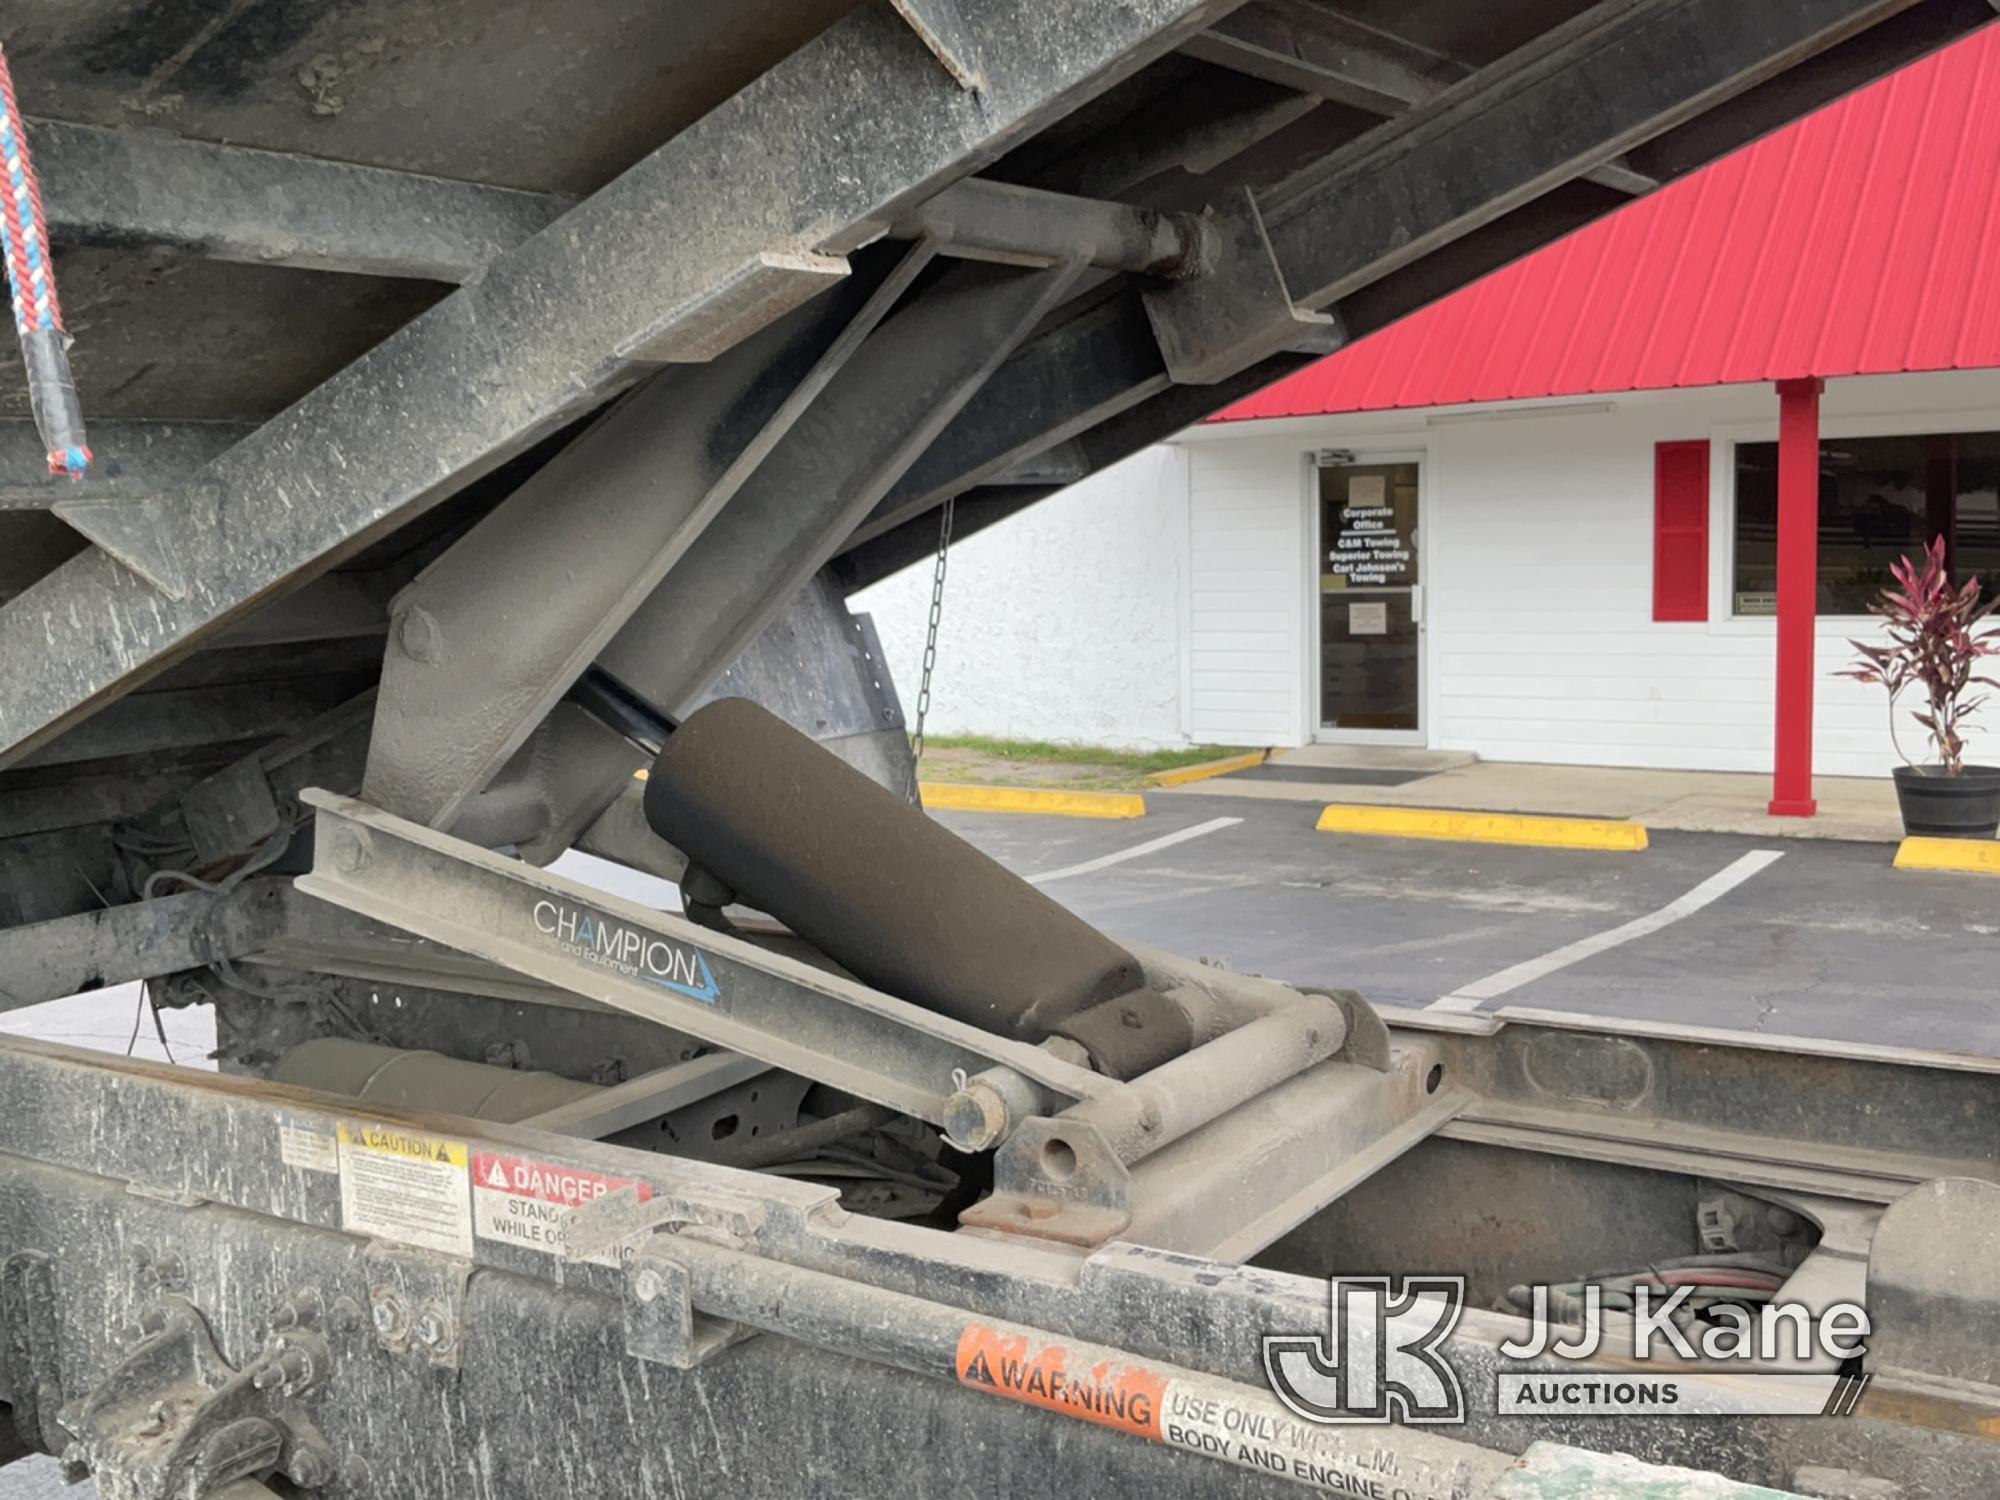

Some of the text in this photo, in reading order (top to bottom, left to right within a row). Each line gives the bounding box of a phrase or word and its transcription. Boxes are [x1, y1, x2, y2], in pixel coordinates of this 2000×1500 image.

[1343, 508, 1394, 519] Corporate
[1353, 520, 1384, 530] Office
[1363, 537, 1400, 549] Towing
[1329, 550, 1410, 562] Superior Towing
[1333, 562, 1405, 573] Carl Johnson's
[1350, 573, 1386, 584] Towing
[534, 900, 697, 986] CHAMPION
[561, 942, 582, 956] and
[369, 1132, 433, 1157] CAUTION
[513, 1166, 607, 1201] DANGER
[508, 1199, 559, 1224] STAND
[493, 1217, 541, 1242] WHILE
[1001, 1357, 1152, 1426] WARNING
[1170, 1392, 1285, 1442] USE ONLY
[1168, 1424, 1231, 1457] BODY
[1237, 1445, 1287, 1473] AND
[1293, 1463, 1388, 1500] ENGINE
